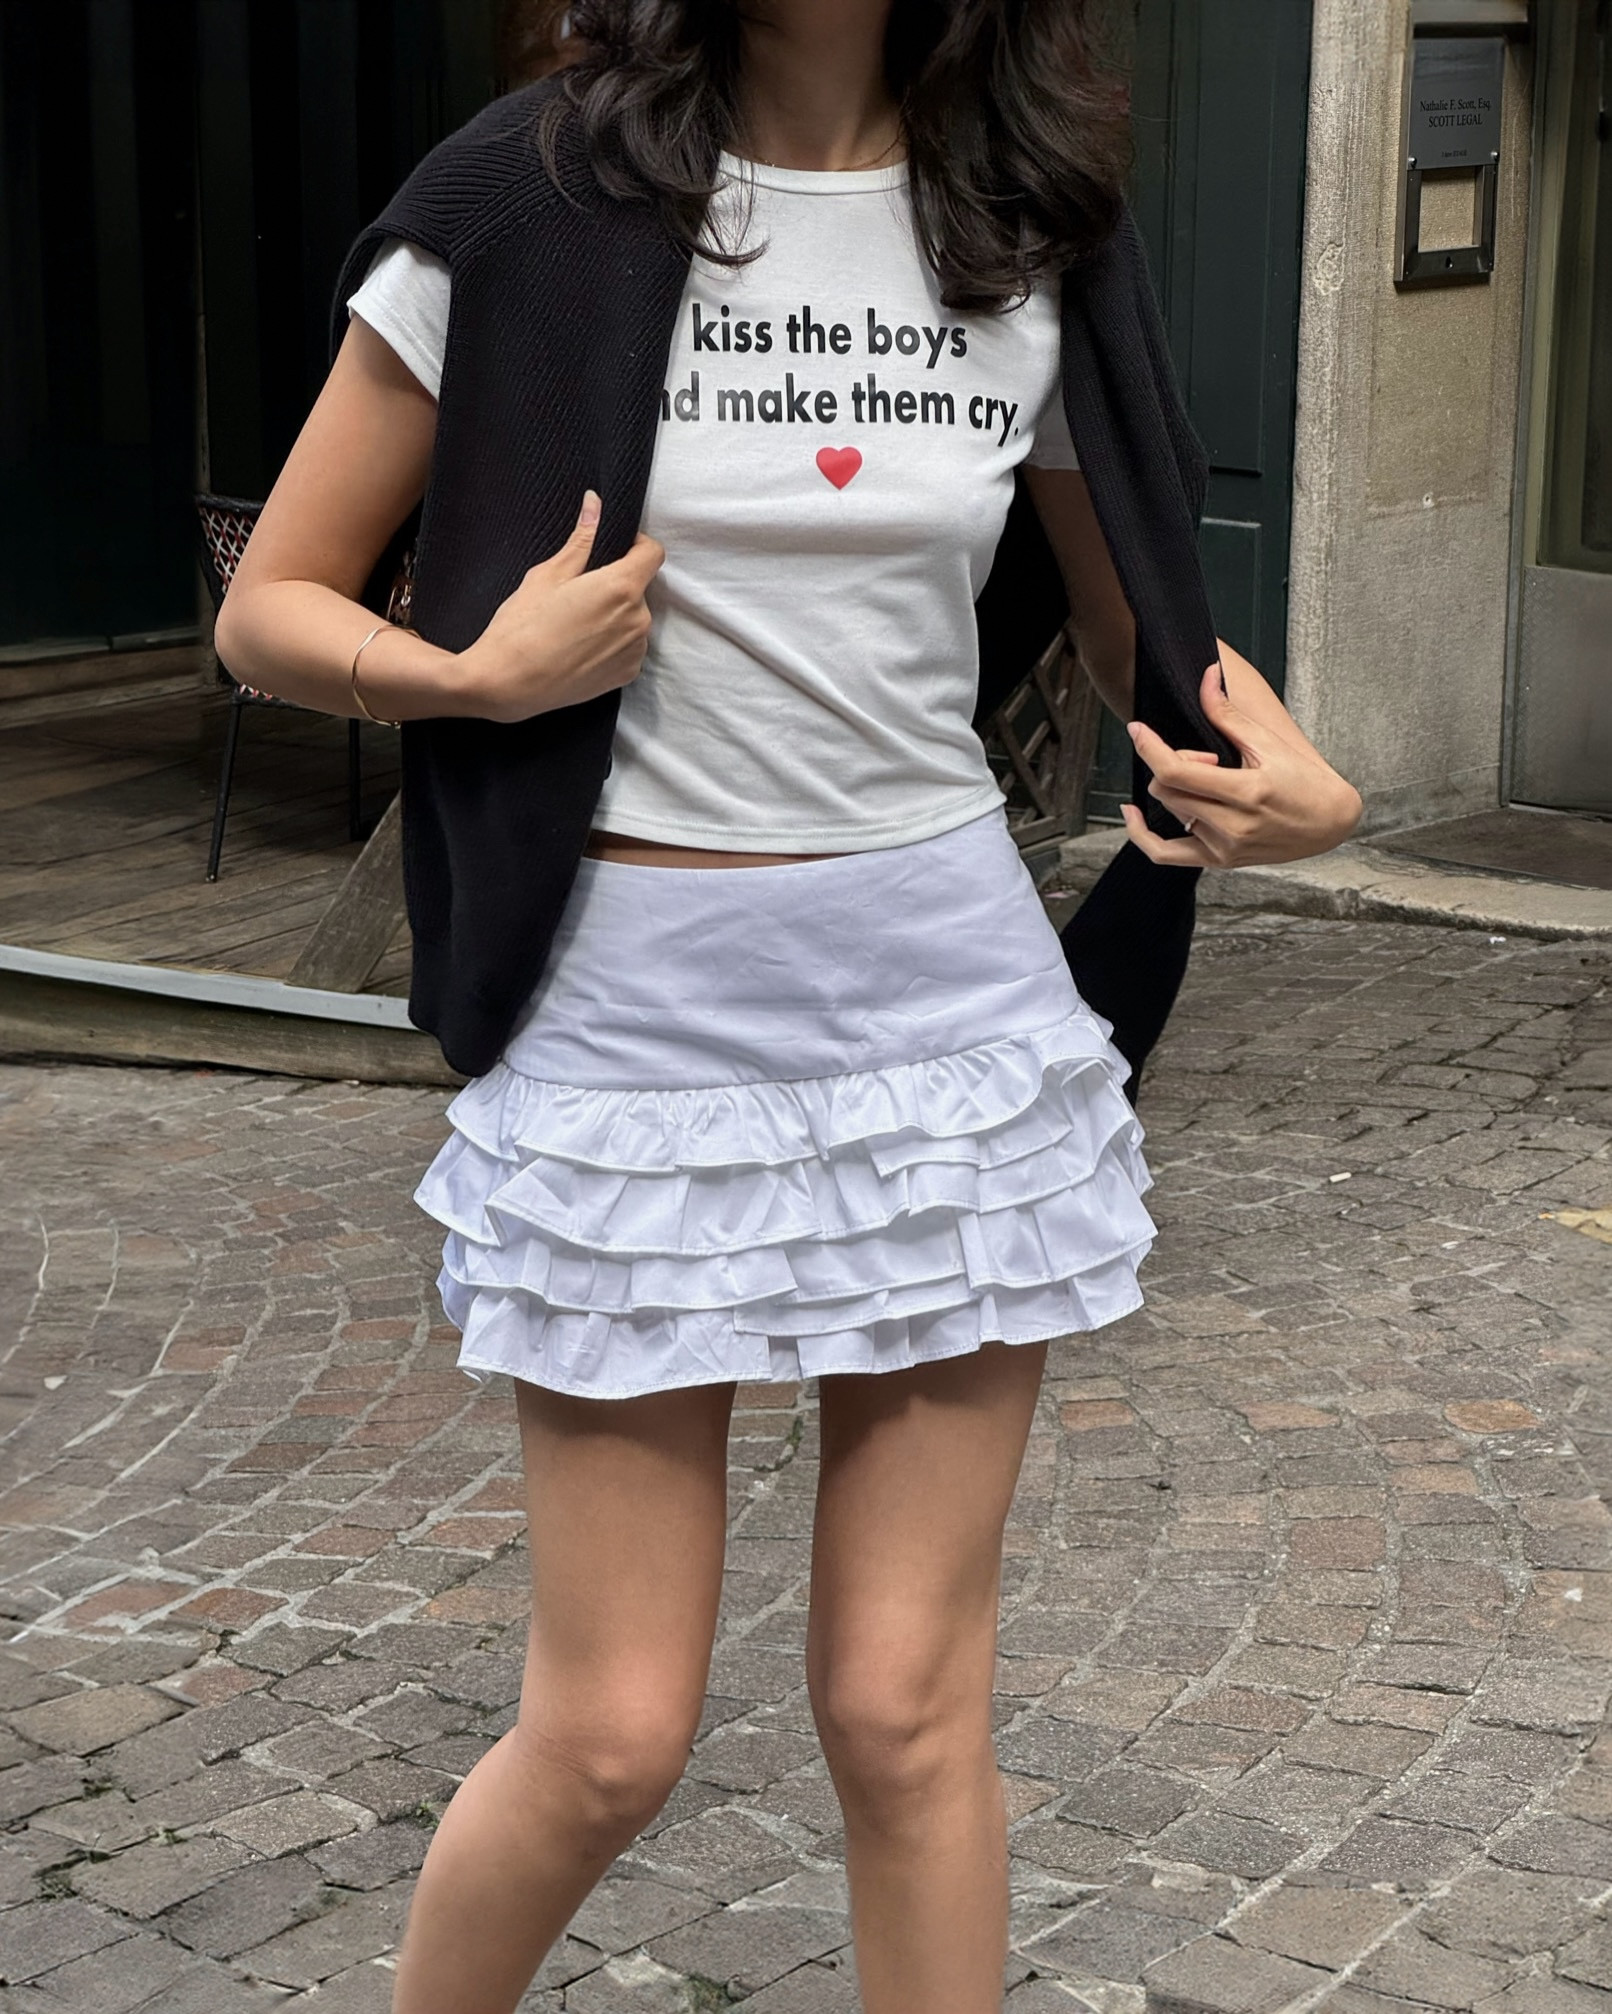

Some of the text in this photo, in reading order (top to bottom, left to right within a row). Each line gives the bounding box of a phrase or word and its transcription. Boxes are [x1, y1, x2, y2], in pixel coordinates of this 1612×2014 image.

[1420, 99, 1448, 111] Nathalie
[1428, 113, 1483, 128] SCOTT LEGAL
[692, 303, 968, 369] kiss the boys
[660, 370, 1018, 447] nd make them cry.
